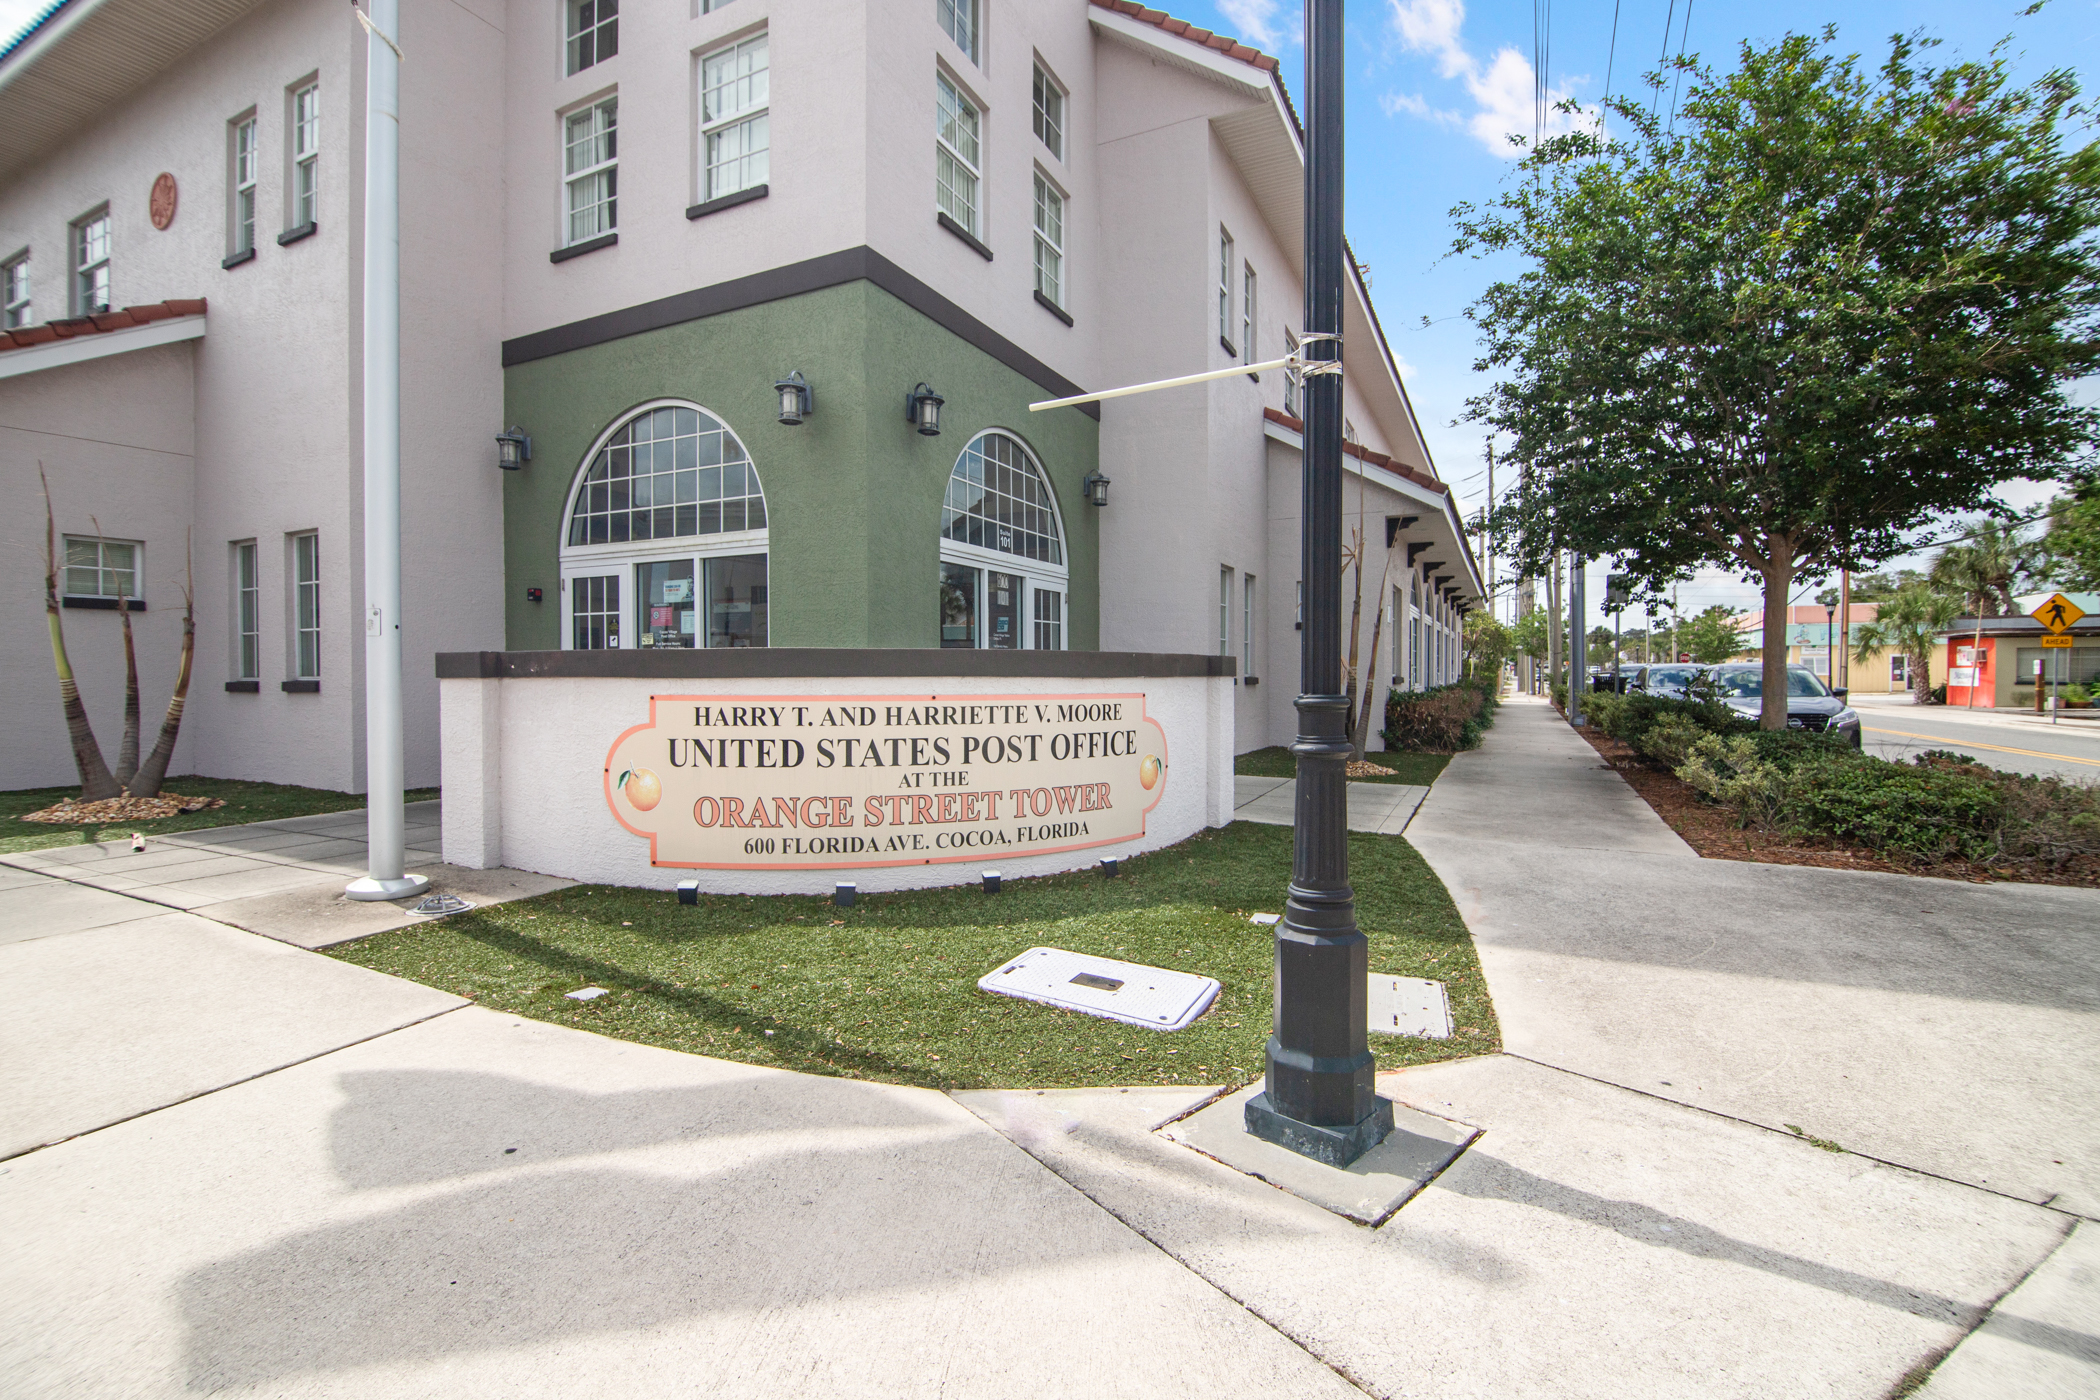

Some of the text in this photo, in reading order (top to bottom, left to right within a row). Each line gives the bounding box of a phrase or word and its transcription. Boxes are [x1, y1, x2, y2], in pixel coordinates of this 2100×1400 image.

[1000, 536, 1010, 548] 101
[693, 703, 1122, 727] HARRY T. AND HARRIETTE V. MOORE
[667, 730, 1138, 768] UNITED STATES POST OFFICE
[898, 771, 969, 788] AT THE
[693, 782, 1113, 829] ORANGE STREET TOWER
[744, 821, 1090, 855] 600 FLORIDA AVE. COCOA, FLORIDA
